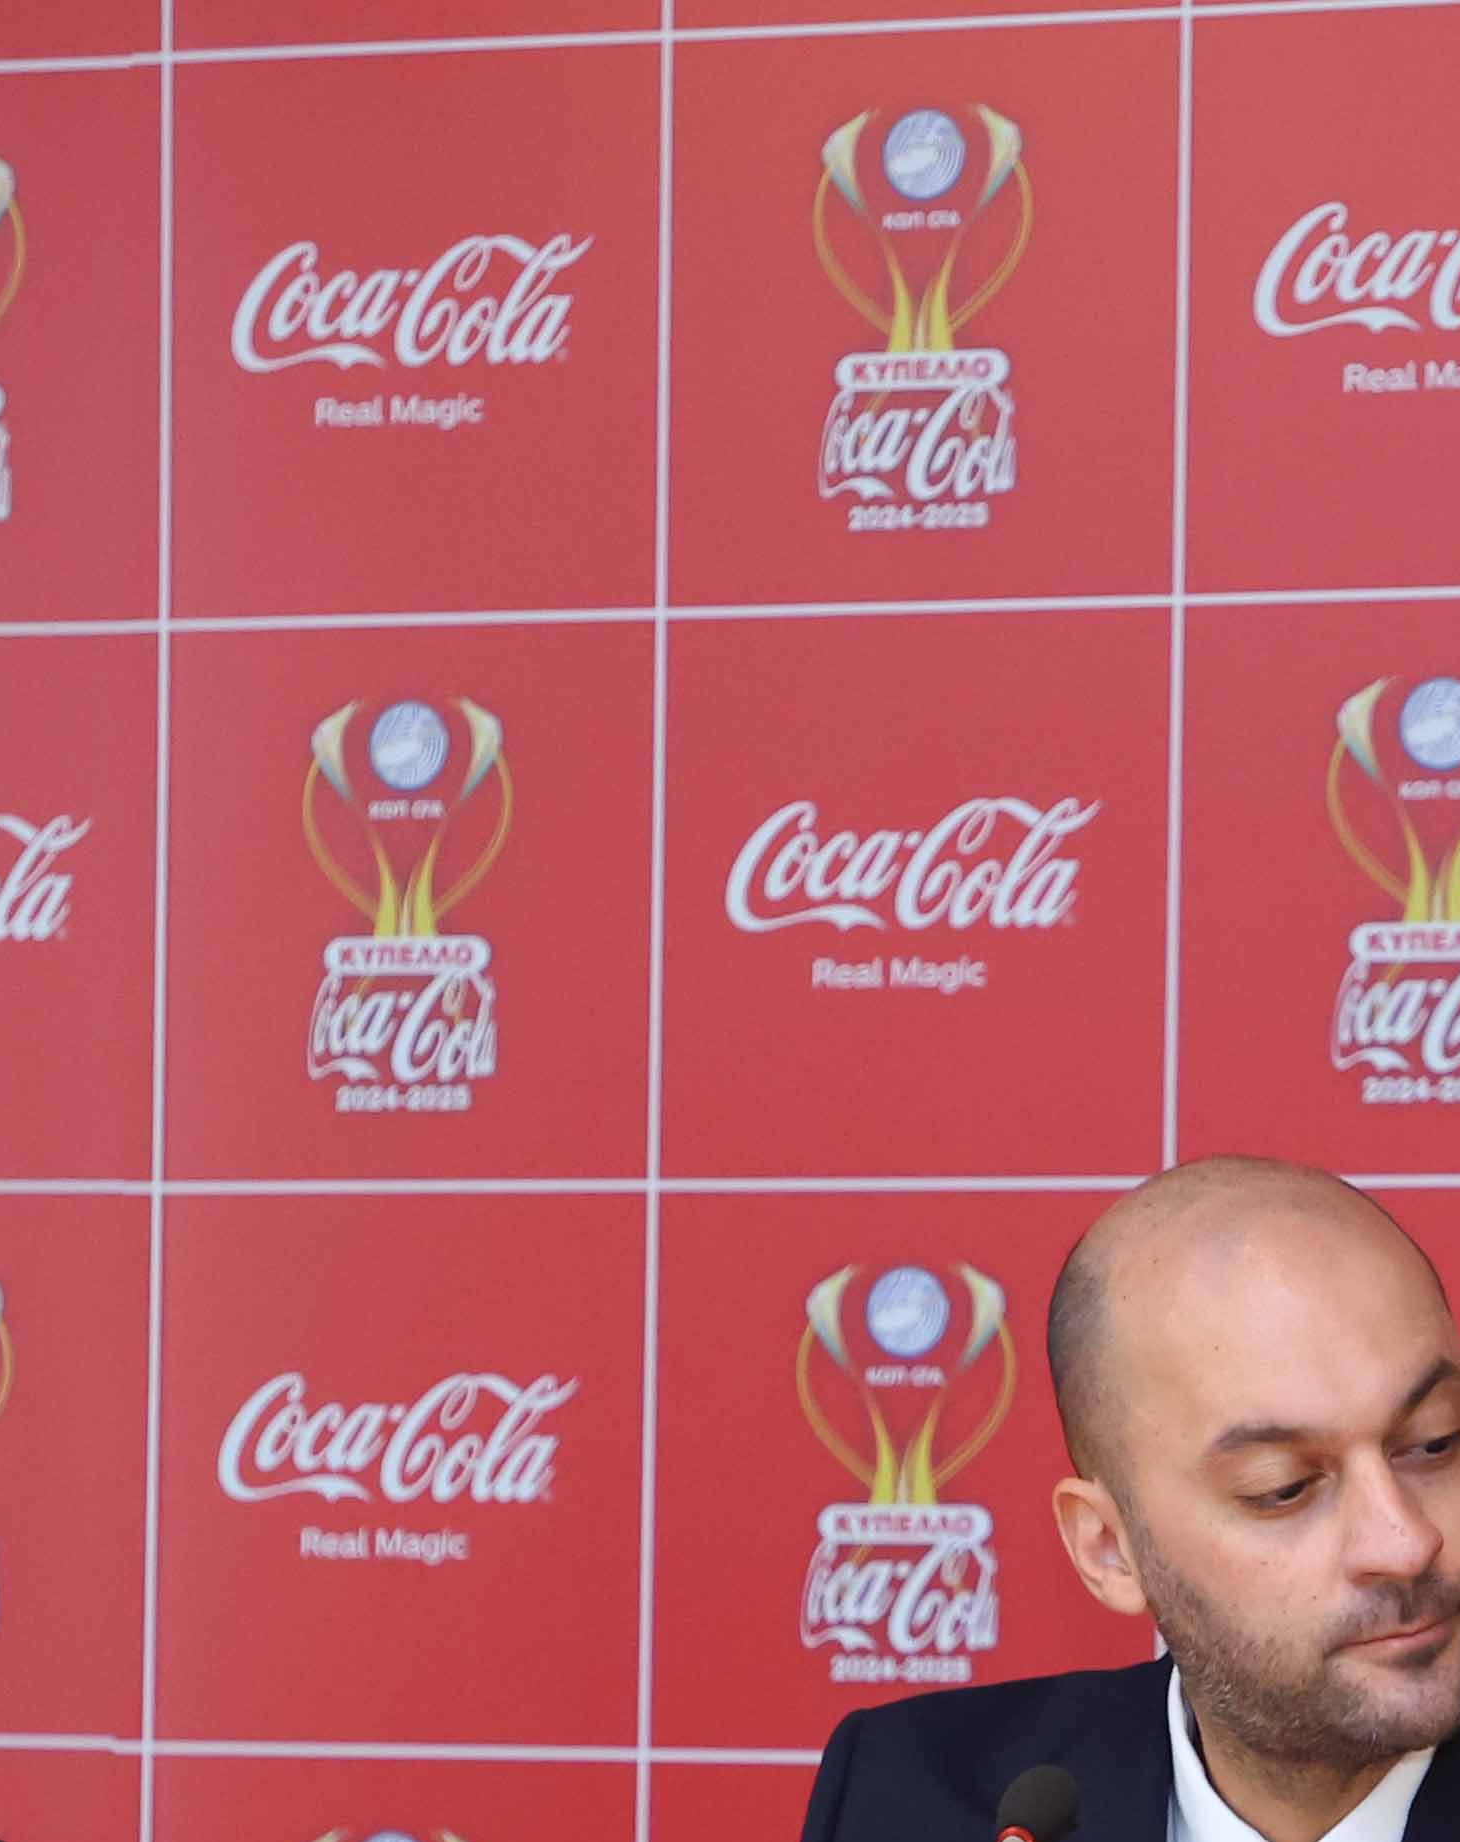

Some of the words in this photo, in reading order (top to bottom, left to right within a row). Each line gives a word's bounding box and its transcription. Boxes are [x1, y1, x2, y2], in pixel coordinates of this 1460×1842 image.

[231, 234, 592, 372] Coca-Cola
[850, 358, 994, 383] ΚΥΠΕΛΛΟ
[1343, 360, 1418, 392] Real
[315, 396, 383, 427] Real
[390, 393, 484, 430] Magic
[726, 798, 1100, 931] Coca-Cola
[337, 942, 477, 968] ΚΥΠΕΛΛΟ
[812, 957, 883, 989] Real
[890, 956, 986, 993] Magic
[218, 1373, 577, 1502] Coca-Cola
[300, 1527, 369, 1559] Real
[375, 1528, 467, 1565] Magic
